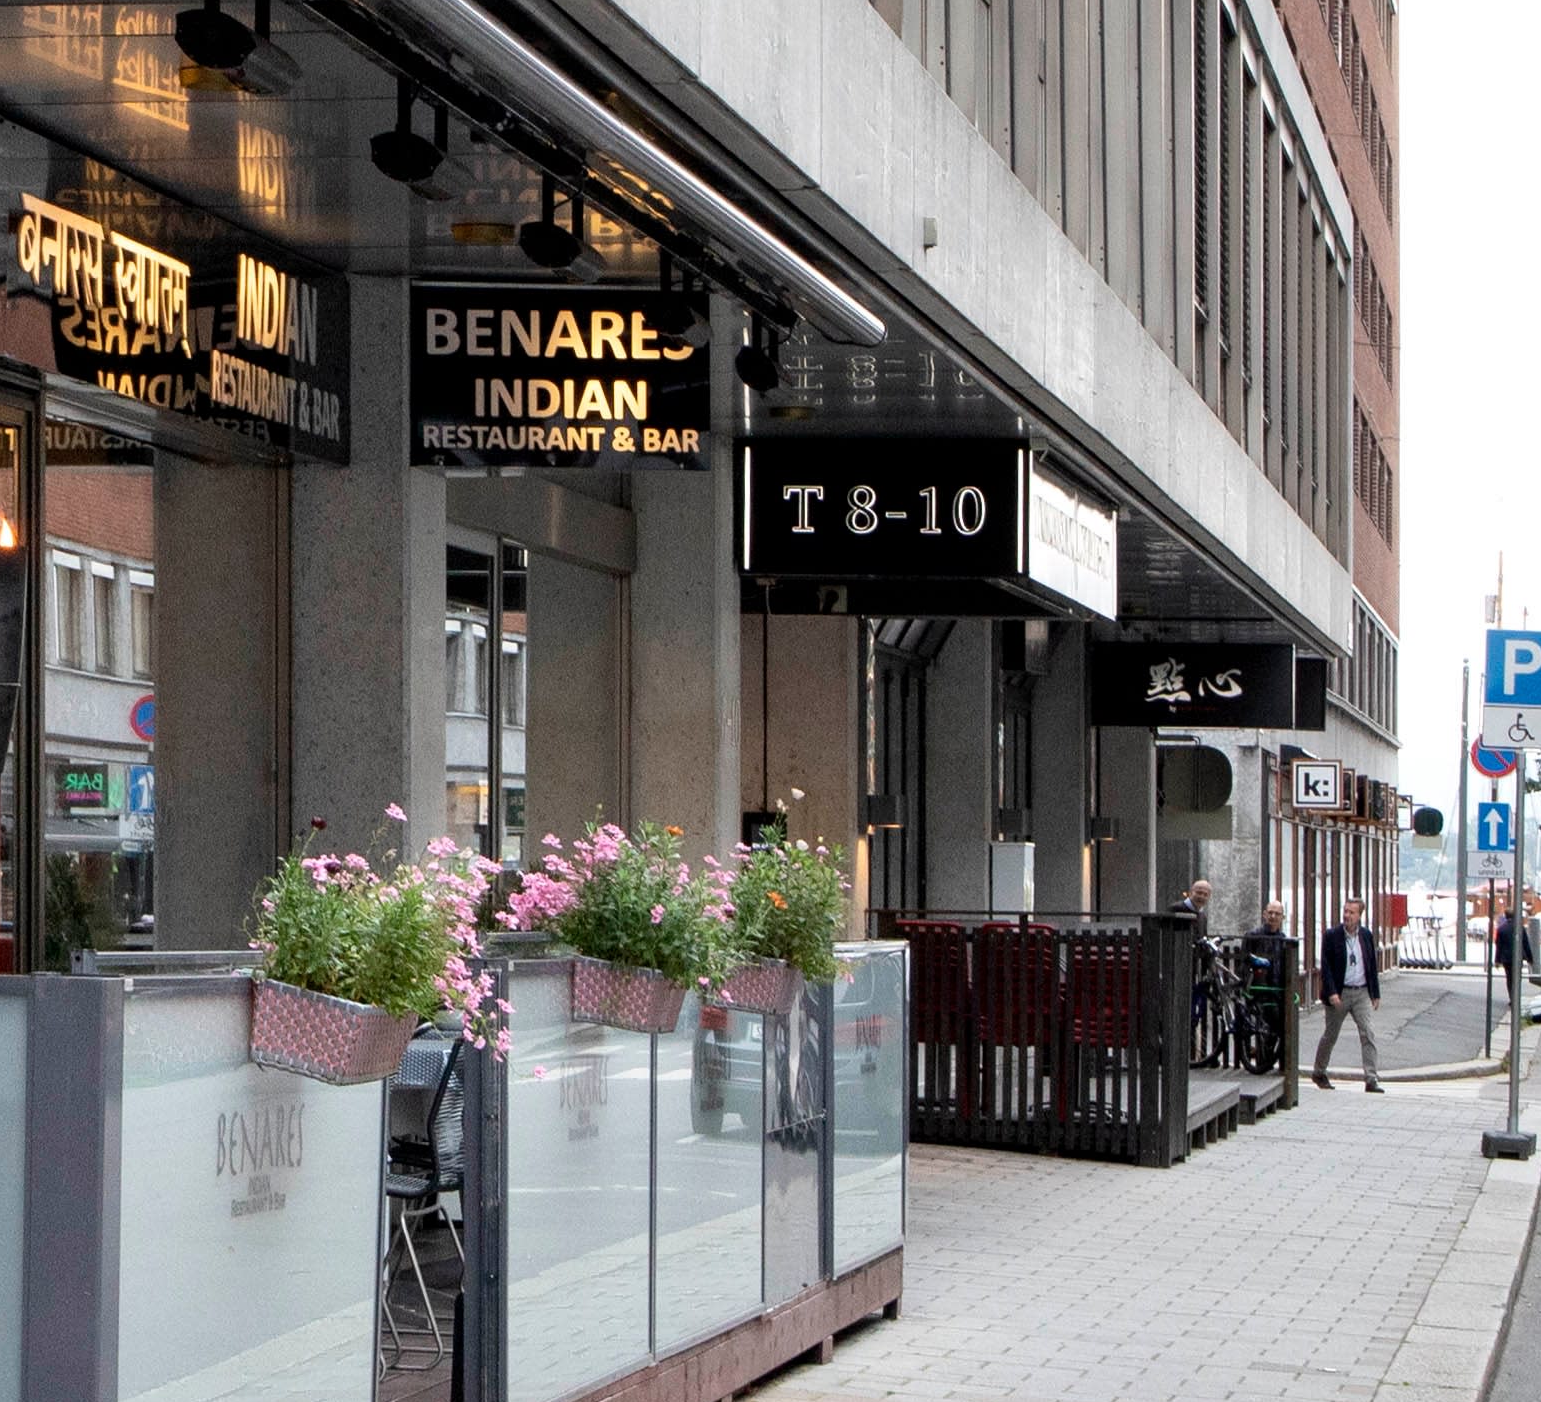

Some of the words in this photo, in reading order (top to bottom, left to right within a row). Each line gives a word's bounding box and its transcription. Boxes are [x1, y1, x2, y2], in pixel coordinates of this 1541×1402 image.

[237, 252, 318, 367] INDIAN
[425, 307, 695, 361] BENARE
[210, 349, 297, 428] RESTAURANT
[299, 381, 311, 433] &
[312, 388, 340, 442] BAR
[474, 378, 648, 420] INDIAN
[422, 424, 606, 452] RESTAURANT
[611, 427, 636, 453] &
[642, 428, 701, 453] BAR
[782, 484, 824, 534] T
[844, 484, 988, 535] 8-10
[215, 1101, 307, 1177] BENARES
